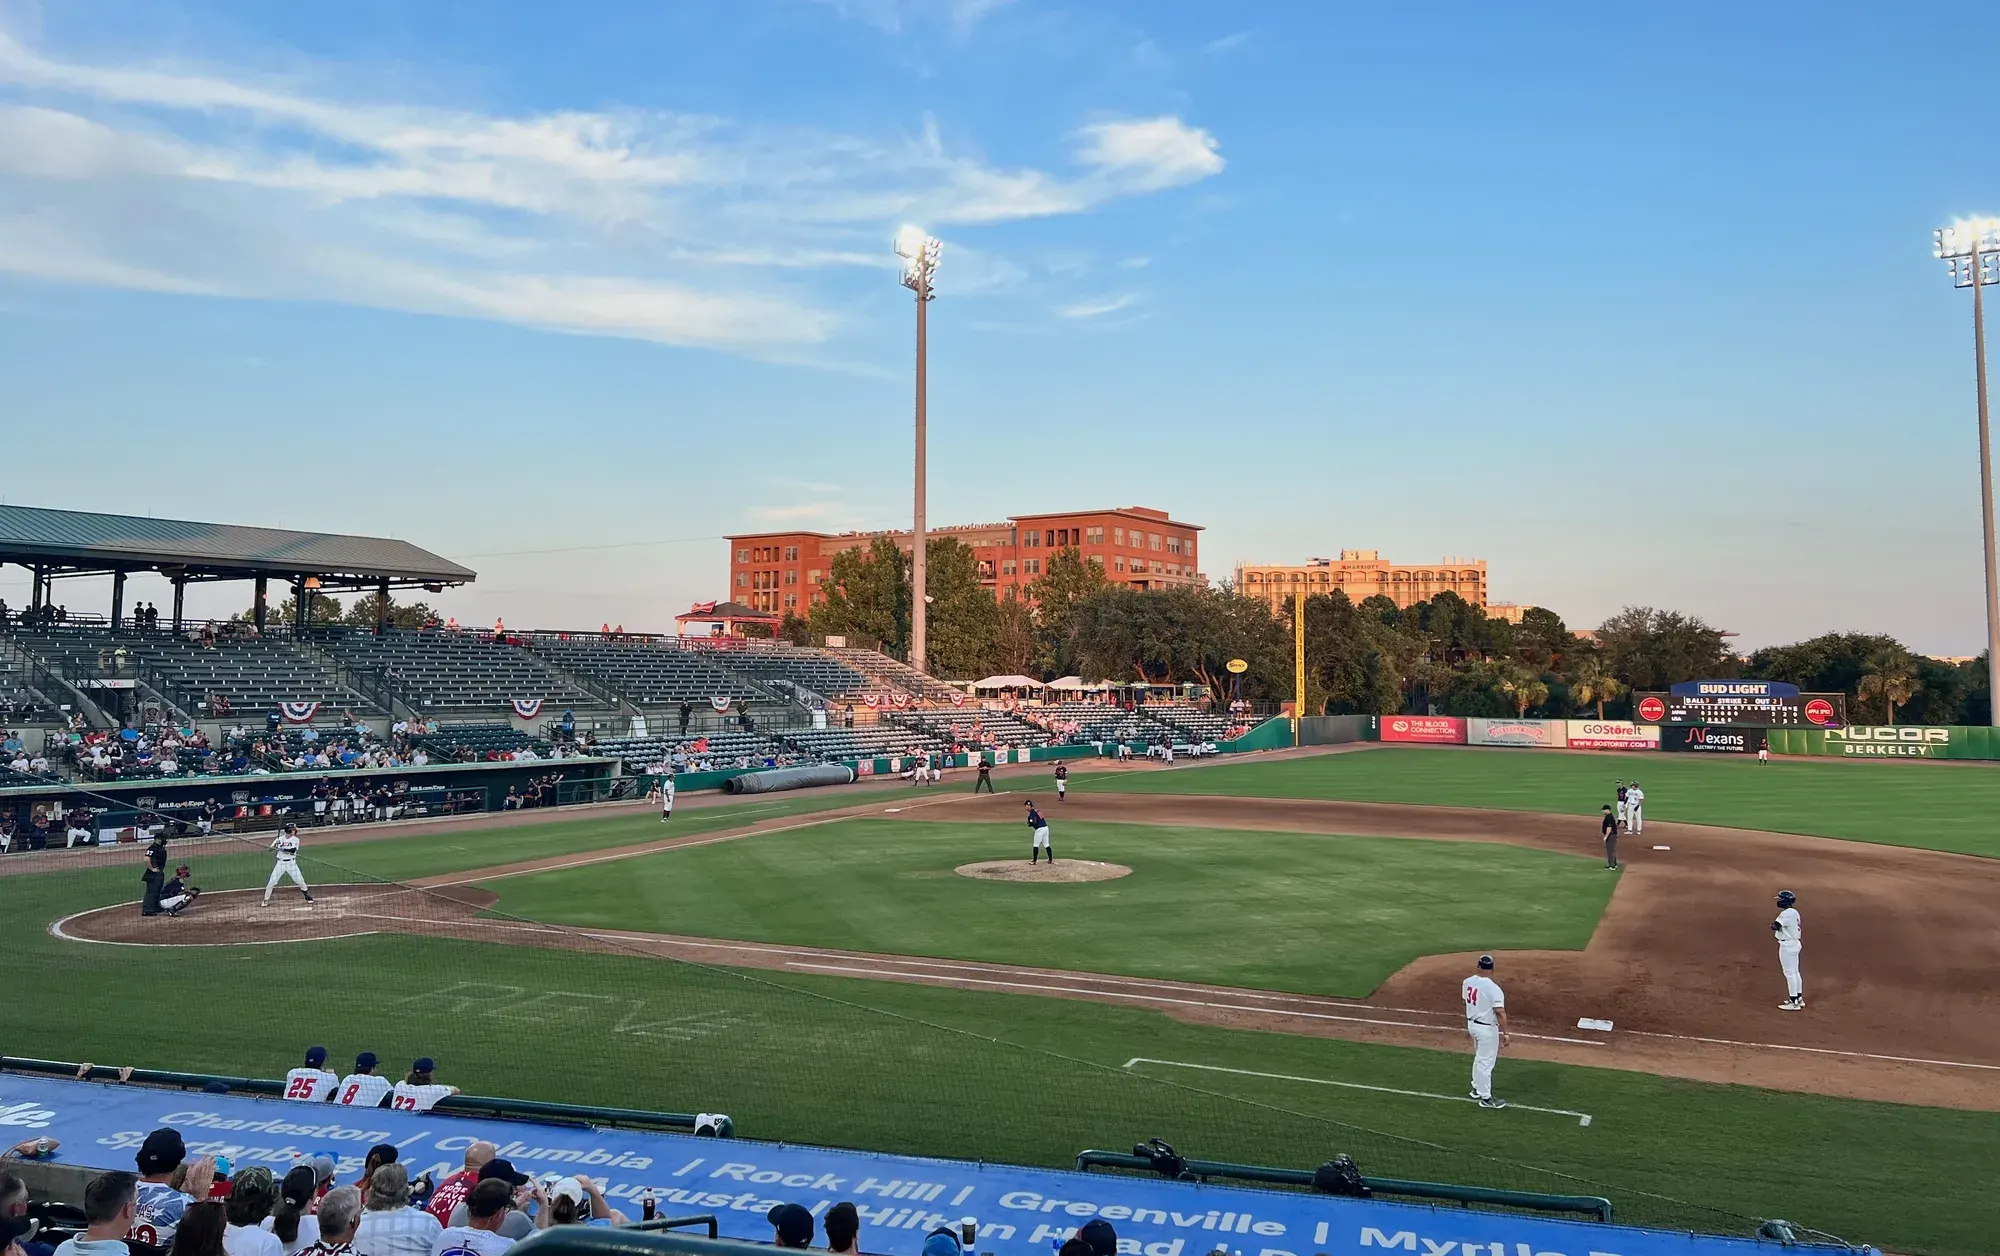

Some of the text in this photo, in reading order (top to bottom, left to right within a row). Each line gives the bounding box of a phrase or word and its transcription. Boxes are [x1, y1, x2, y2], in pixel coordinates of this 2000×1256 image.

[1699, 684, 1768, 695] BUD LIGHT
[1410, 727, 1456, 735] CONNECTION
[1685, 727, 1744, 745] Nexans
[1825, 726, 1949, 742] NUCOR
[1572, 740, 1647, 748] WWW.GOSTOREIT.COM
[1845, 744, 1927, 756] BERKELEY
[1466, 985, 1479, 1007] 34
[287, 1077, 318, 1099] 25
[341, 1083, 360, 1105] 8
[157, 1110, 392, 1144] Charleston
[434, 1135, 654, 1170] Clumbia
[708, 1162, 848, 1192] Rock
[852, 1177, 947, 1202] Hill
[998, 1191, 1287, 1237] Greenville
[1027, 1223, 1186, 1256] Had
